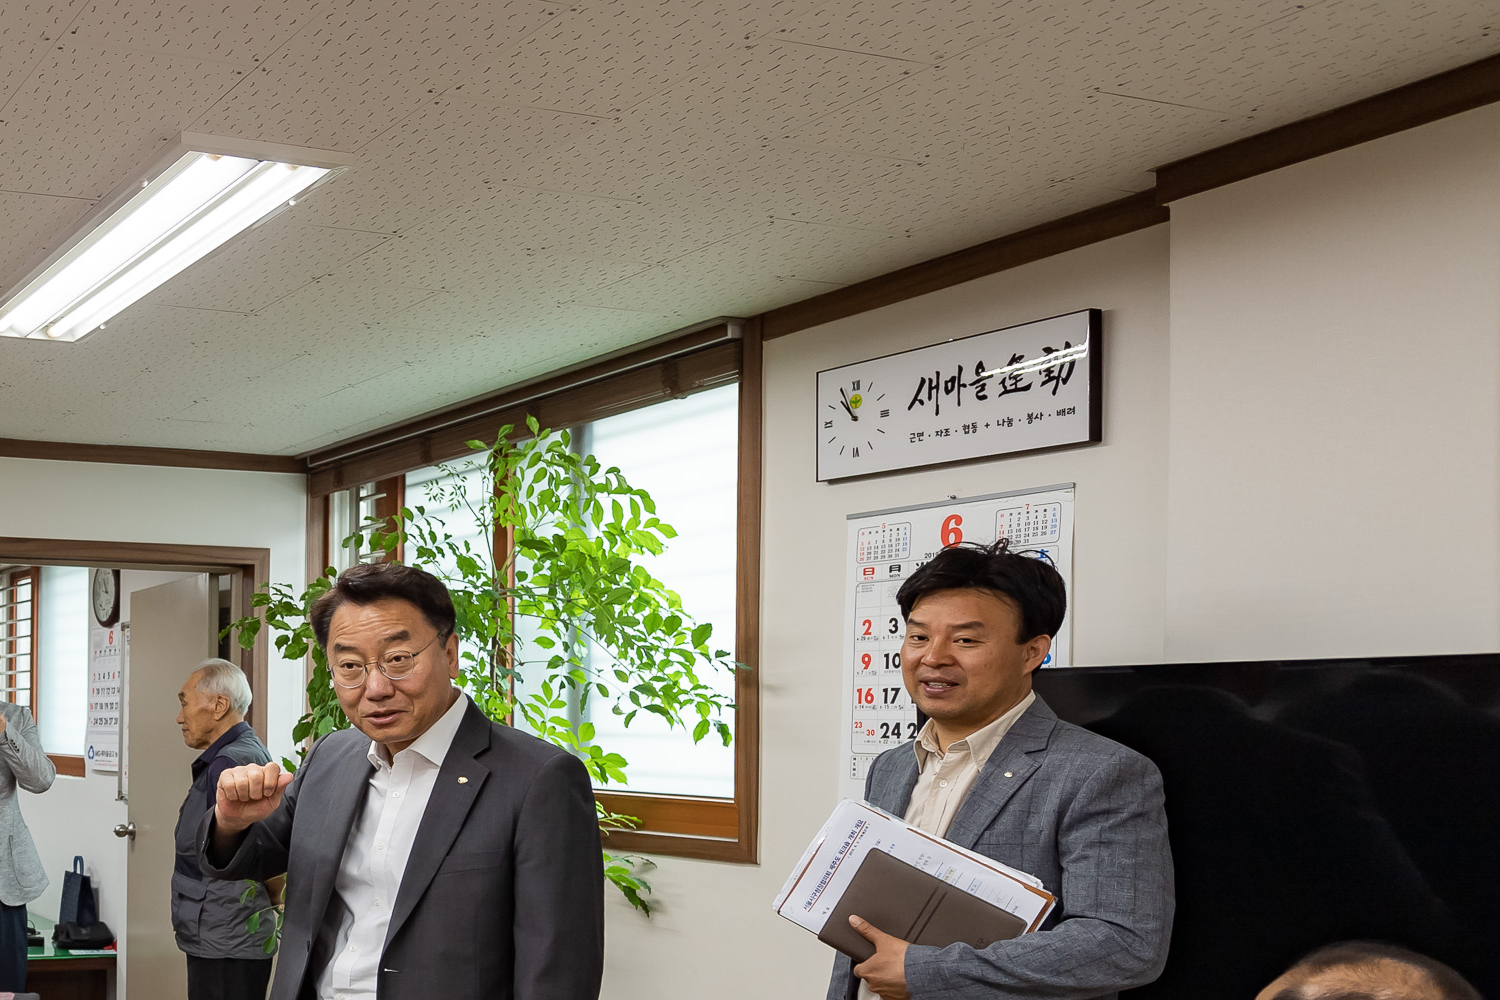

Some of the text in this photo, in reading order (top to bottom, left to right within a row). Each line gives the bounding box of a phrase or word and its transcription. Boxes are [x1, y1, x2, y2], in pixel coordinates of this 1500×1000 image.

[909, 406, 1076, 443] 근면 자조 협동 나눔 봉사 배려
[941, 514, 962, 548] 6
[863, 567, 875, 576] 日
[889, 564, 901, 574] 月
[862, 618, 898, 636] 2 3
[109, 630, 113, 645] 6
[862, 653, 901, 670] 9 10
[856, 688, 901, 704] 16 17
[880, 722, 917, 739] 24 2
